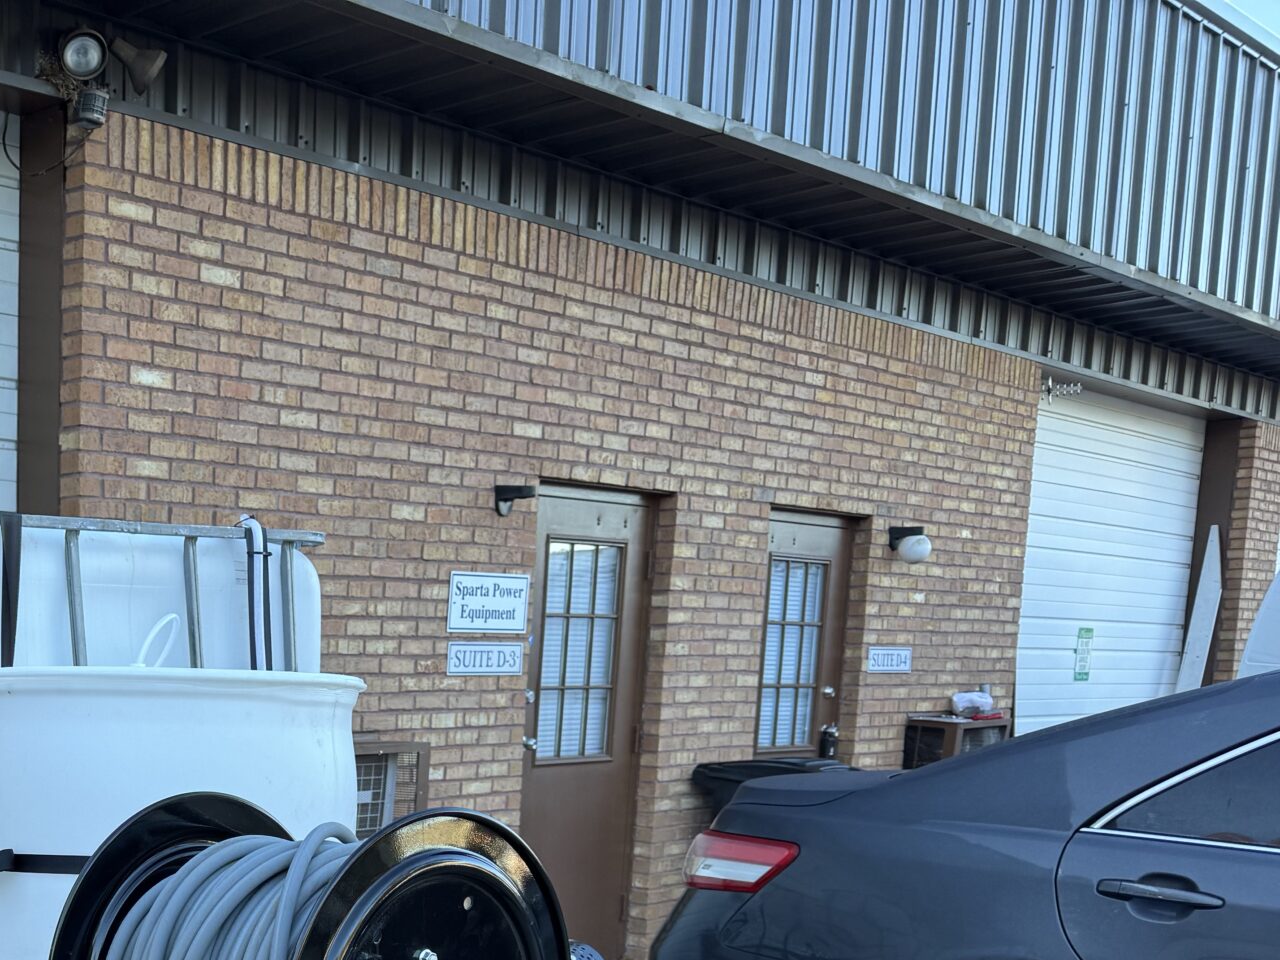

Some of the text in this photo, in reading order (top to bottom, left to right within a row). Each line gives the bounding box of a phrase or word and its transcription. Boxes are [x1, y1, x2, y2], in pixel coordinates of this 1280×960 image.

[455, 581, 524, 600] Sparta Power
[460, 604, 516, 623] Equipment
[454, 650, 517, 668] SUITE D-3
[872, 653, 907, 667] SUITE D-4
